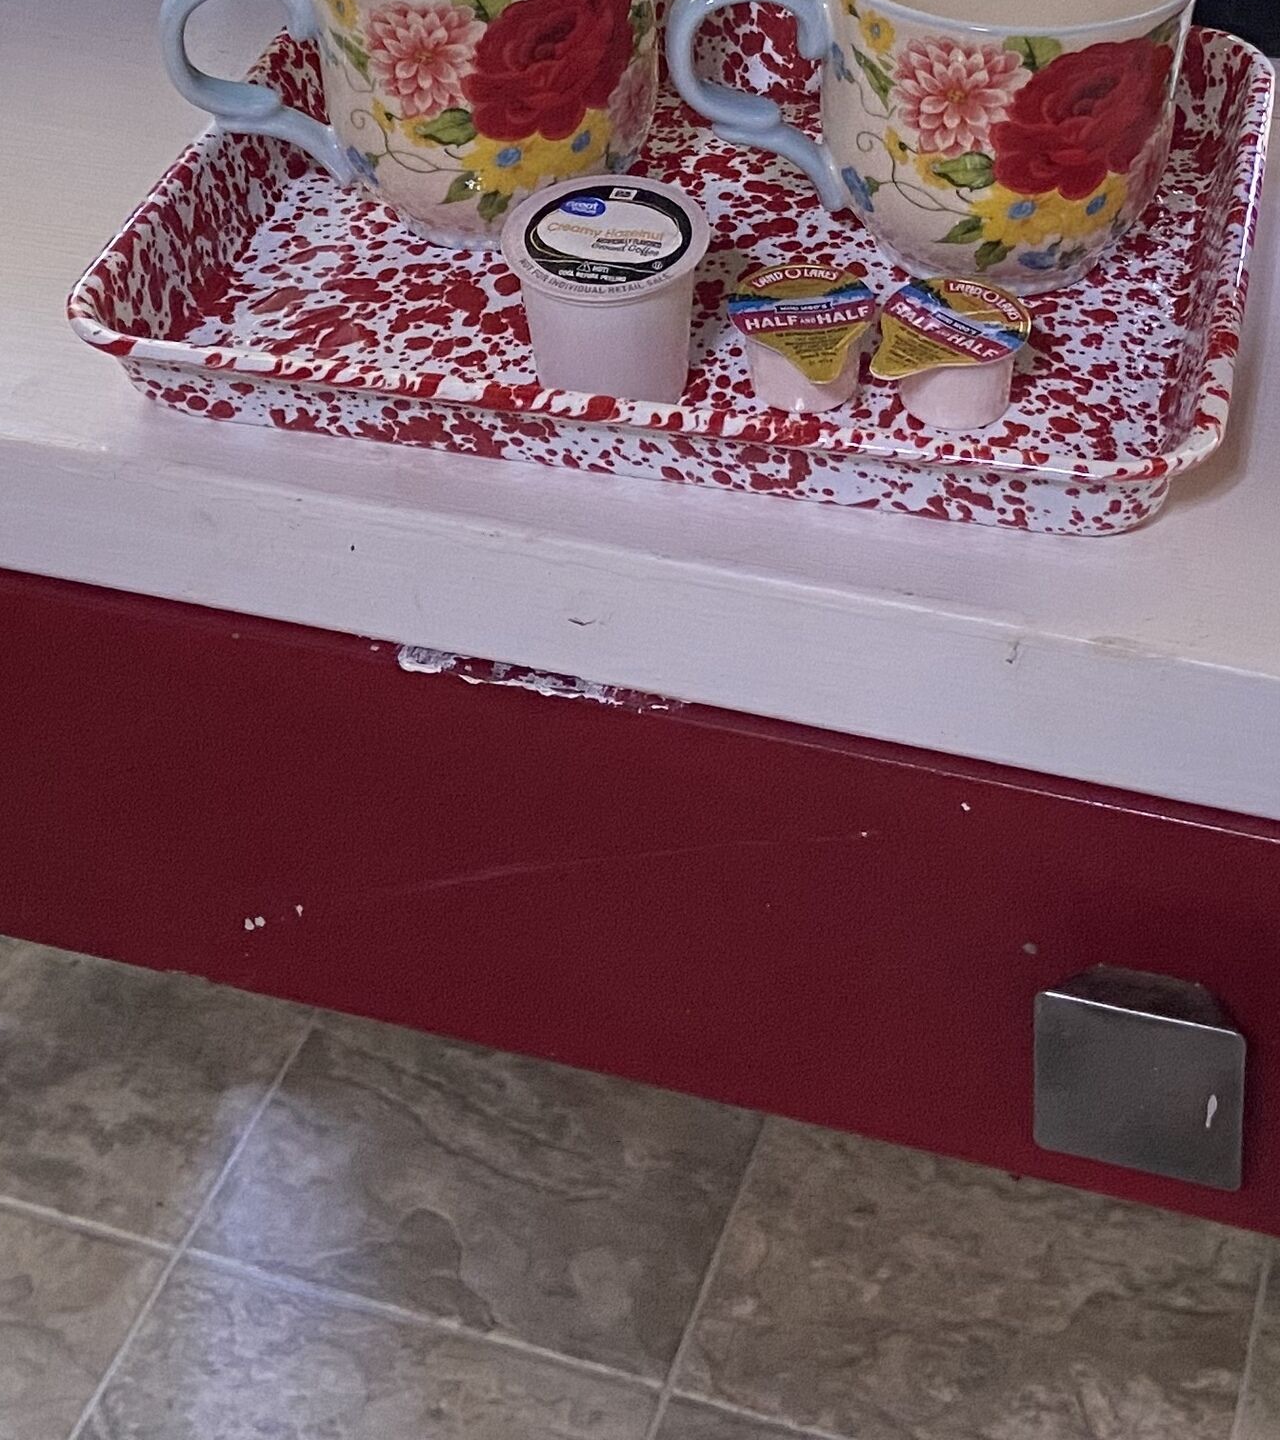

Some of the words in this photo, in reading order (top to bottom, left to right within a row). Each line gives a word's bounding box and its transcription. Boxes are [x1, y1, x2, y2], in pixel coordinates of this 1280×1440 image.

[547, 222, 603, 239] Creamy
[605, 228, 665, 241] Hazelnut
[530, 268, 548, 283] FOR
[548, 274, 605, 295] INDIVIDUAL
[608, 283, 643, 294] RETAIL
[752, 271, 783, 288] LAND
[784, 268, 802, 279] O
[949, 282, 982, 297] LAND
[982, 290, 998, 303] O
[744, 315, 799, 331] HALF
[800, 317, 817, 325] AND
[816, 305, 870, 325] HALF
[890, 301, 942, 332] HALF
[947, 333, 1000, 358] HALF
